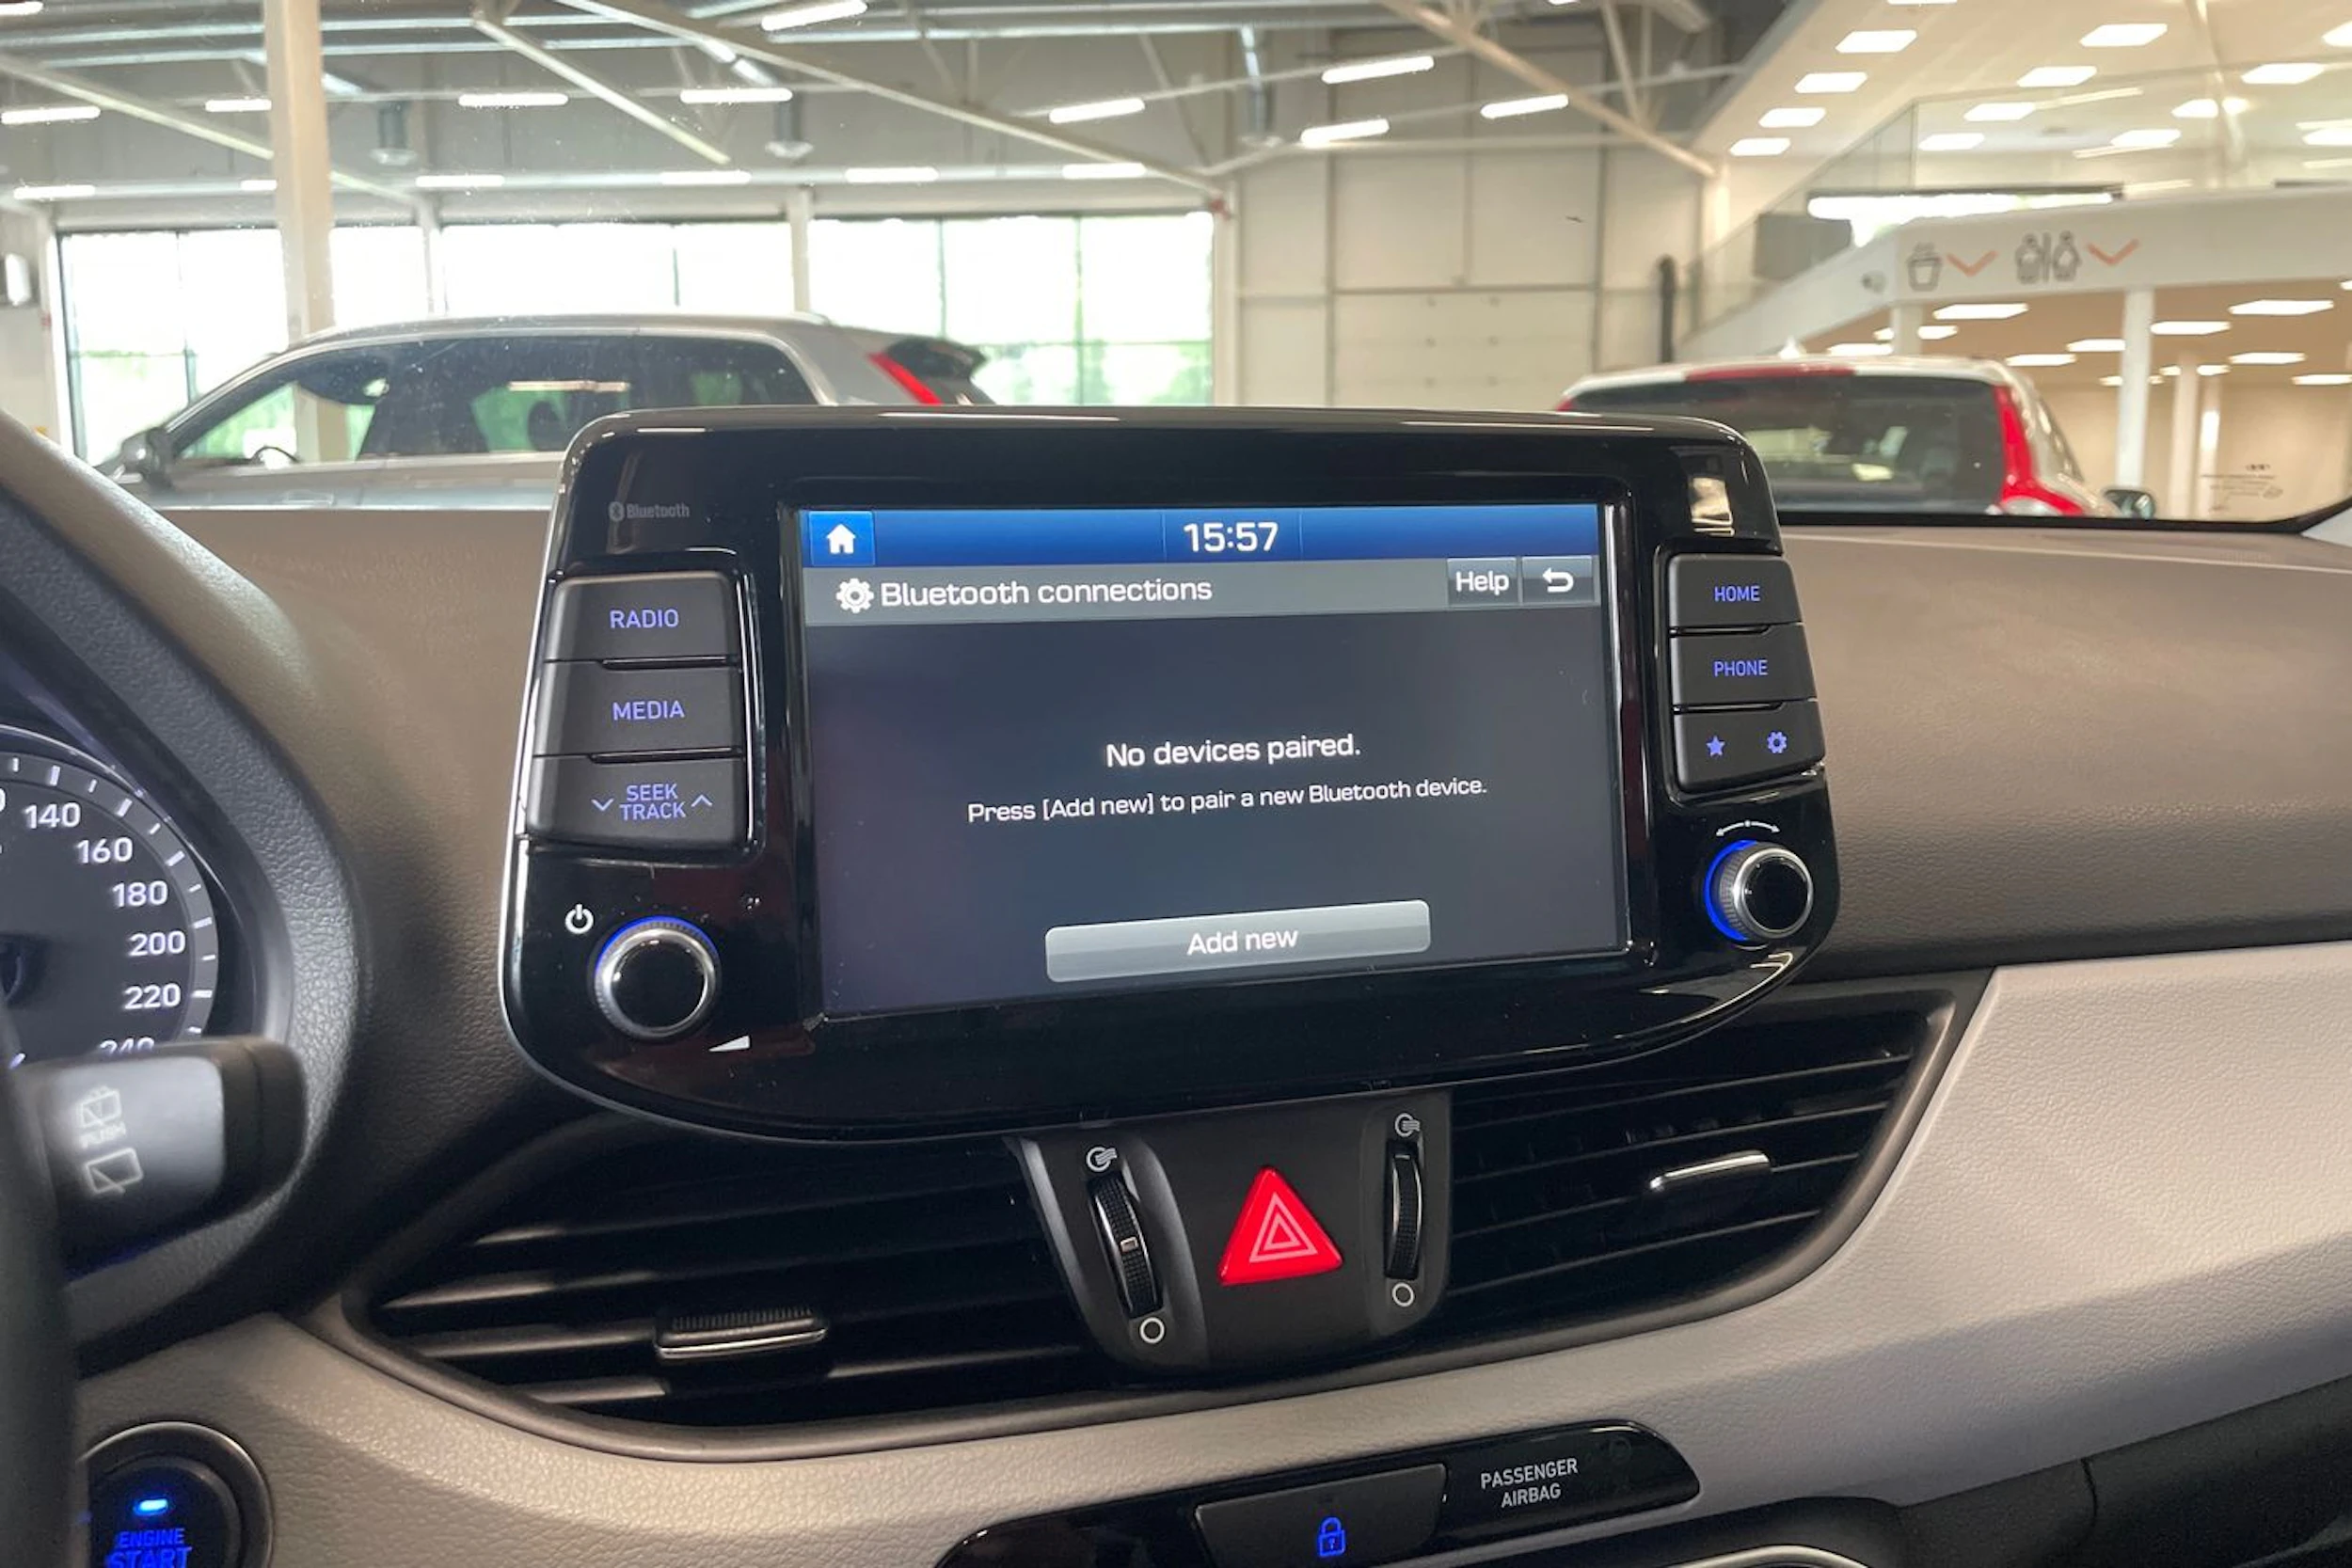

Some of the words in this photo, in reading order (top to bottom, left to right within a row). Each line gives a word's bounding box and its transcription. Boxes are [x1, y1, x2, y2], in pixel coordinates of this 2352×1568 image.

[626, 501, 691, 519] Bluetooth
[1183, 521, 1280, 553] 15:57
[881, 579, 1031, 608] Bluetooth
[1037, 577, 1214, 604] connections
[1454, 569, 1509, 596] Help
[1714, 585, 1761, 603] HOME
[610, 608, 679, 629] RADIO
[1713, 659, 1769, 678] PHONE
[612, 700, 685, 721] MEDIA
[1106, 742, 1146, 768] No
[1152, 738, 1262, 766] devices
[1267, 733, 1361, 765] paired.
[626, 783, 678, 801] SEEK
[968, 802, 1037, 824] Press
[1042, 797, 1095, 821] [Add
[1101, 792, 1154, 816] new]
[1159, 794, 1185, 813] to
[1190, 789, 1236, 815] pair
[1240, 792, 1254, 809] a
[1260, 789, 1306, 807] new
[1309, 780, 1411, 804] Bluetooth
[1415, 776, 1488, 799] device.
[24, 802, 81, 830] 140
[619, 801, 686, 822] TRACK
[75, 836, 133, 864] 160
[111, 880, 168, 908] 180
[128, 930, 186, 957] 200
[1185, 931, 1239, 956] Add
[1244, 928, 1299, 952] new
[123, 983, 182, 1010] 220
[1480, 1457, 1579, 1490] PASSENGER
[1498, 1482, 1562, 1510] AIRBAG
[118, 1528, 185, 1548] ENGINE
